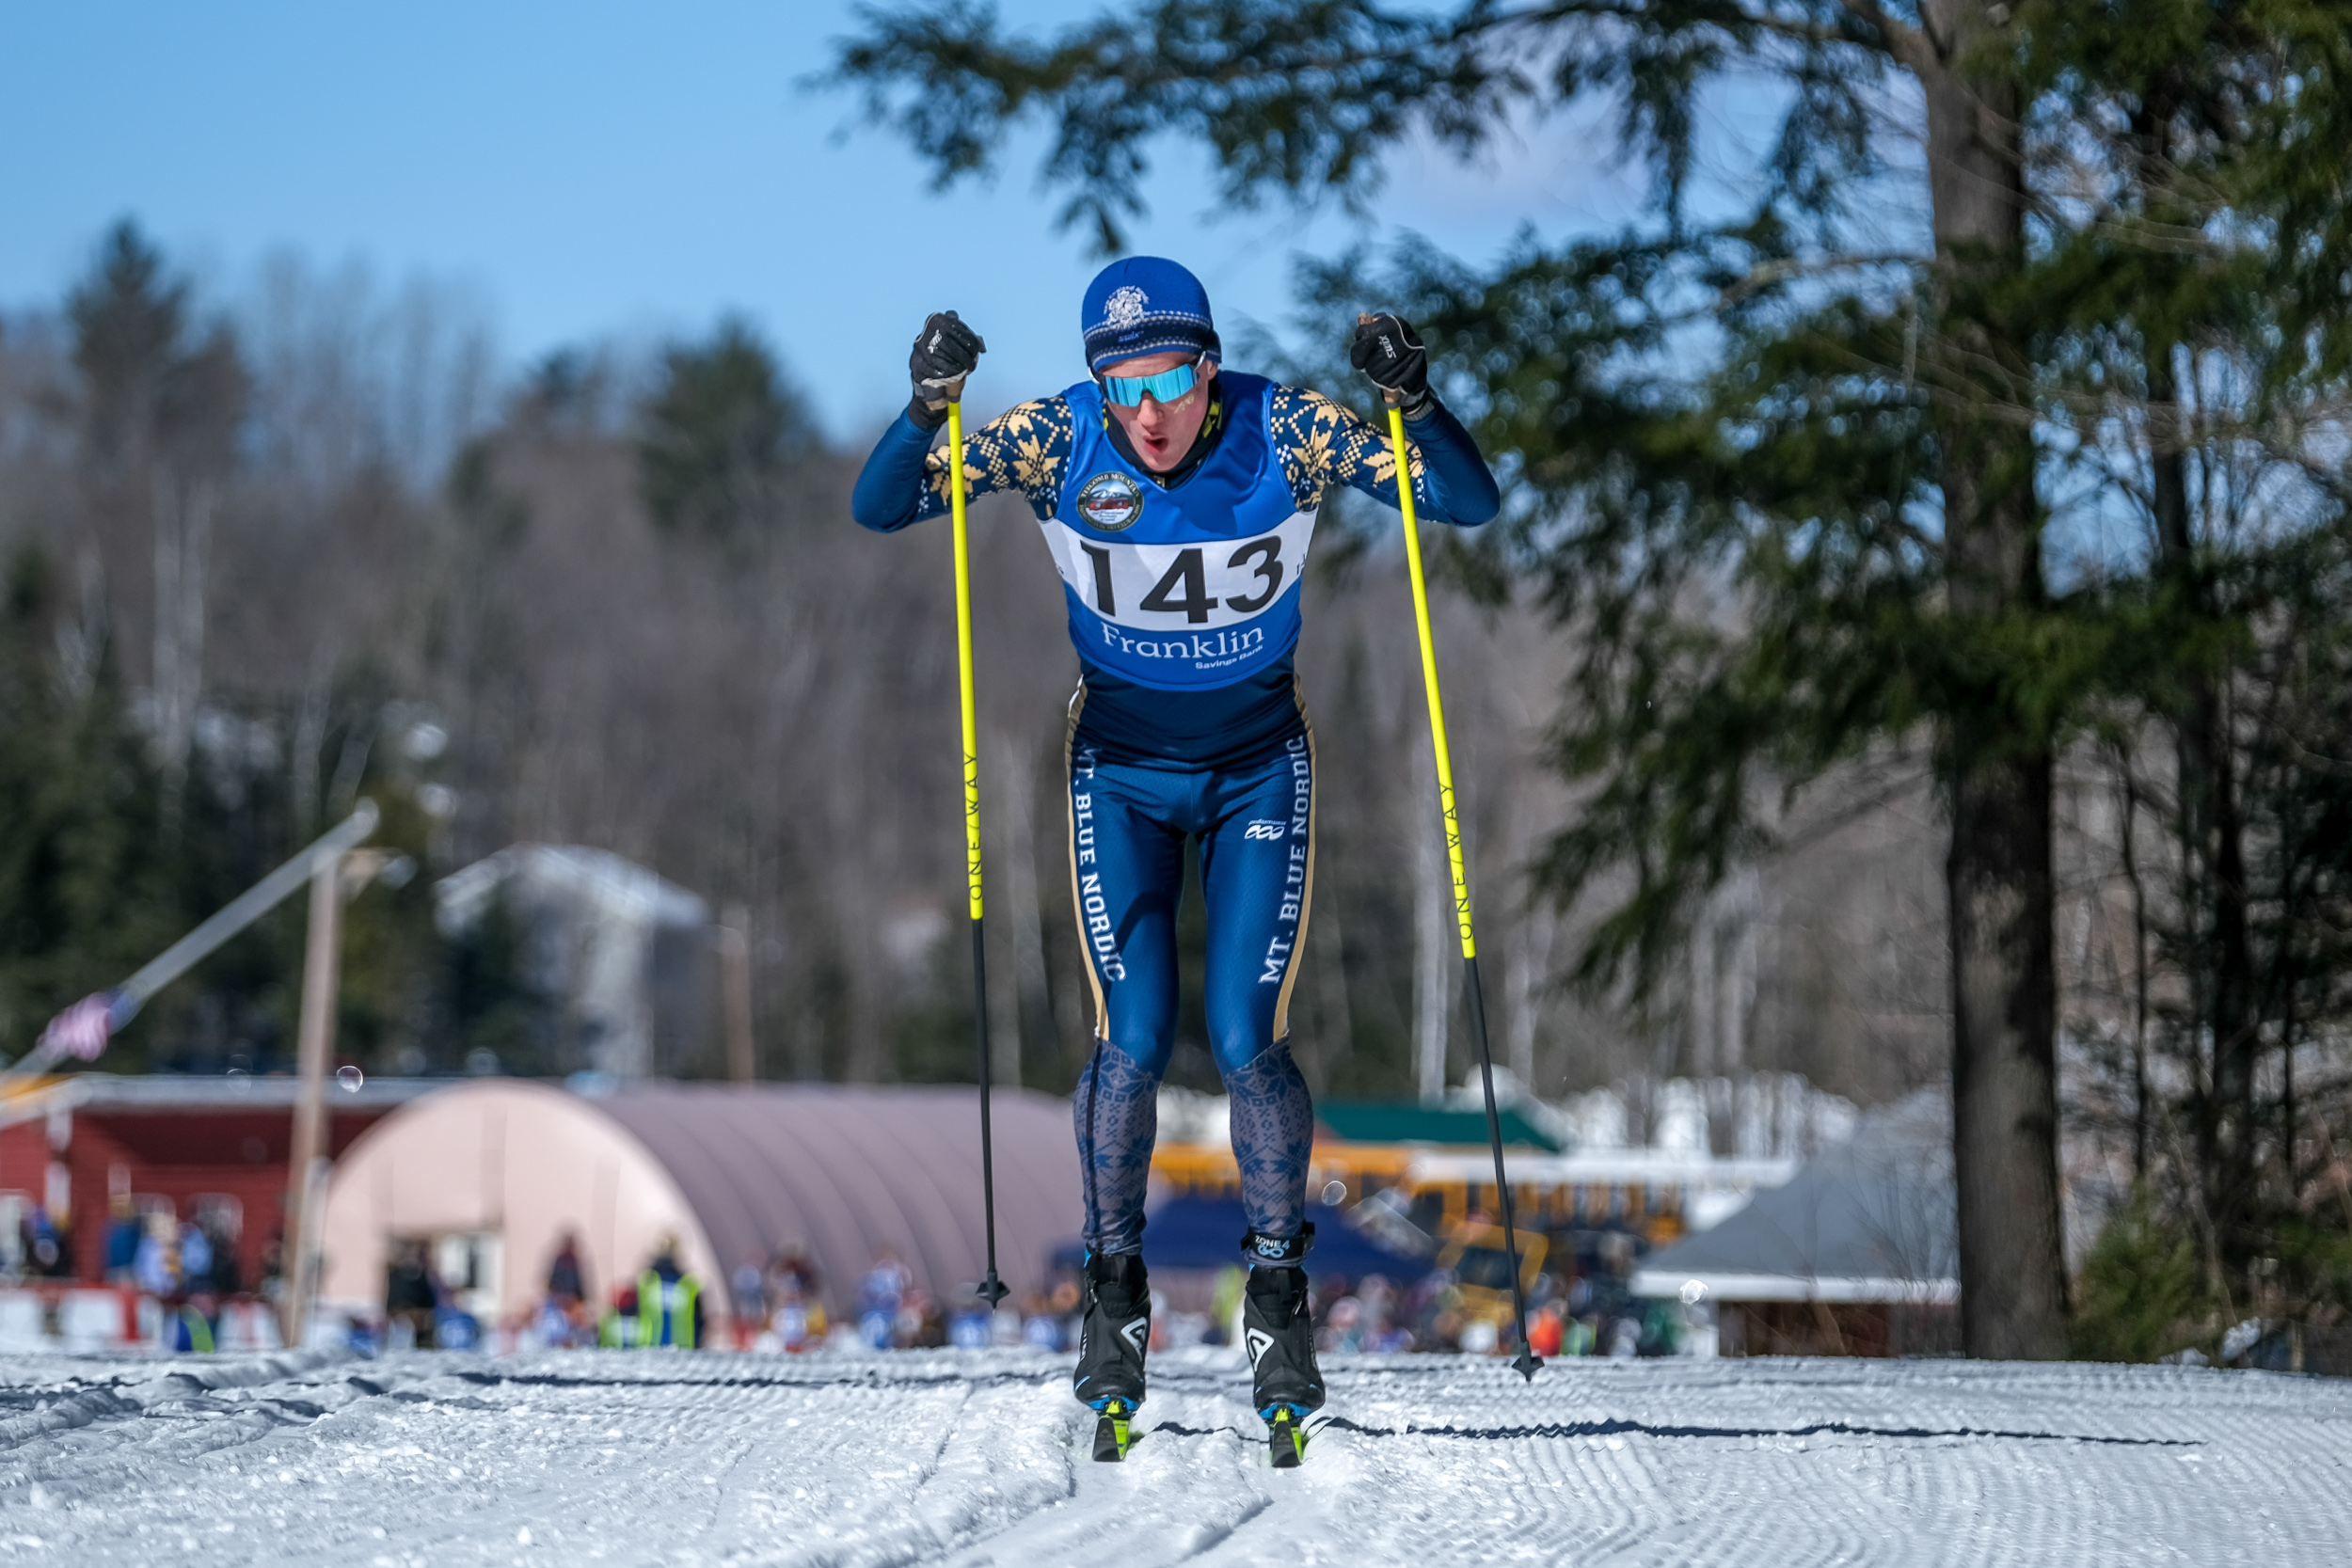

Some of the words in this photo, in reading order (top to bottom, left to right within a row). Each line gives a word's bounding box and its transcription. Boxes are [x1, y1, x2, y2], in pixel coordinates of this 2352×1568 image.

[1079, 534, 1284, 624] 143
[1102, 621, 1264, 659] Franklin
[1195, 657, 1238, 670] Savings
[1239, 644, 1263, 660] Bank
[1286, 734, 1311, 839] NORDIC
[1075, 791, 1097, 866] BLUE
[1278, 844, 1307, 923] BLUE
[1081, 872, 1127, 983] NORDIC
[1258, 929, 1294, 984] MT.
